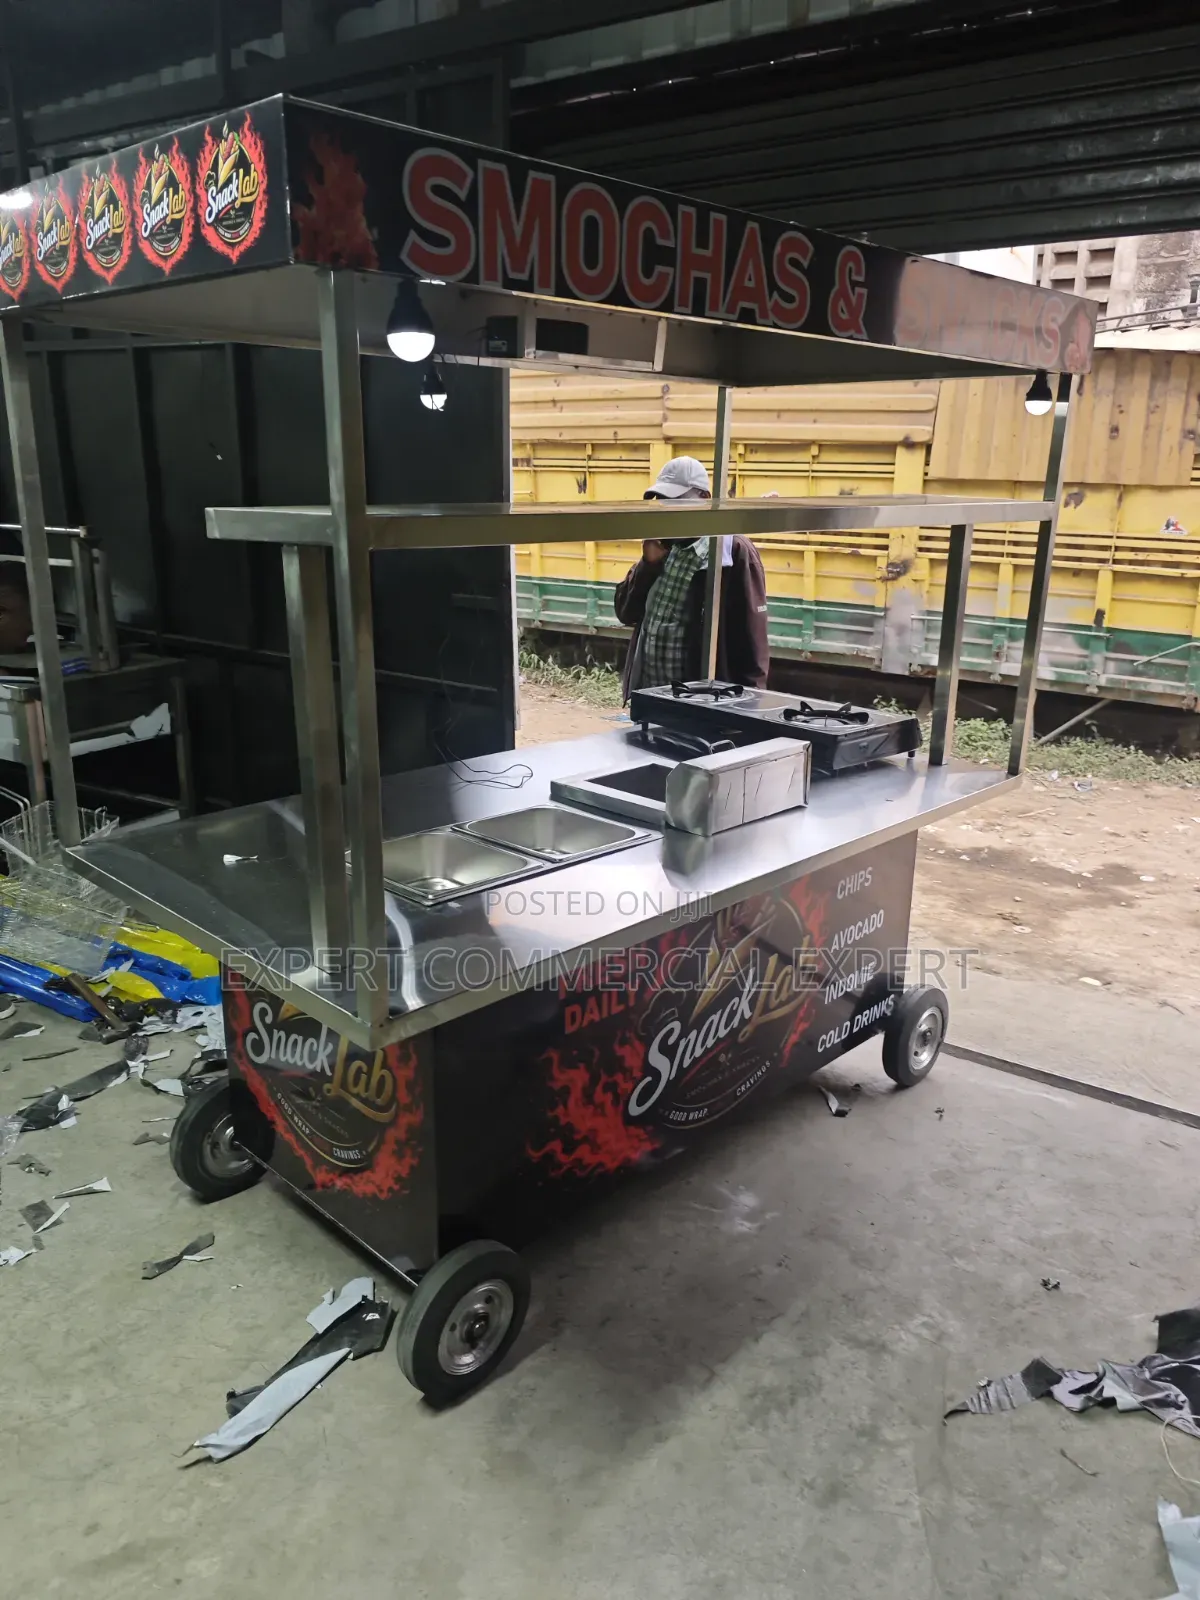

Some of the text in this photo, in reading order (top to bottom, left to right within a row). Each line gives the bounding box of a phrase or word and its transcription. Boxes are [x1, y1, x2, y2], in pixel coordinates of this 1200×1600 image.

[142, 191, 169, 238] Snack
[166, 183, 187, 225] Lab
[206, 163, 260, 224] Snack Lab
[0, 234, 14, 271] nack
[86, 207, 110, 250] Snack
[108, 200, 126, 238] Lab
[401, 147, 1067, 369] SMOCHAS & SCKS
[836, 866, 873, 900] CHIPS
[830, 909, 885, 954] AVOCADO
[564, 976, 642, 1035] DAILY
[824, 961, 877, 1005] INDOMIE
[628, 966, 760, 1116] Snack
[817, 993, 895, 1053] COLD DRINKS
[245, 1001, 333, 1077] Snack
[322, 1033, 398, 1123] Lab
[669, 1109, 687, 1122] GOOD
